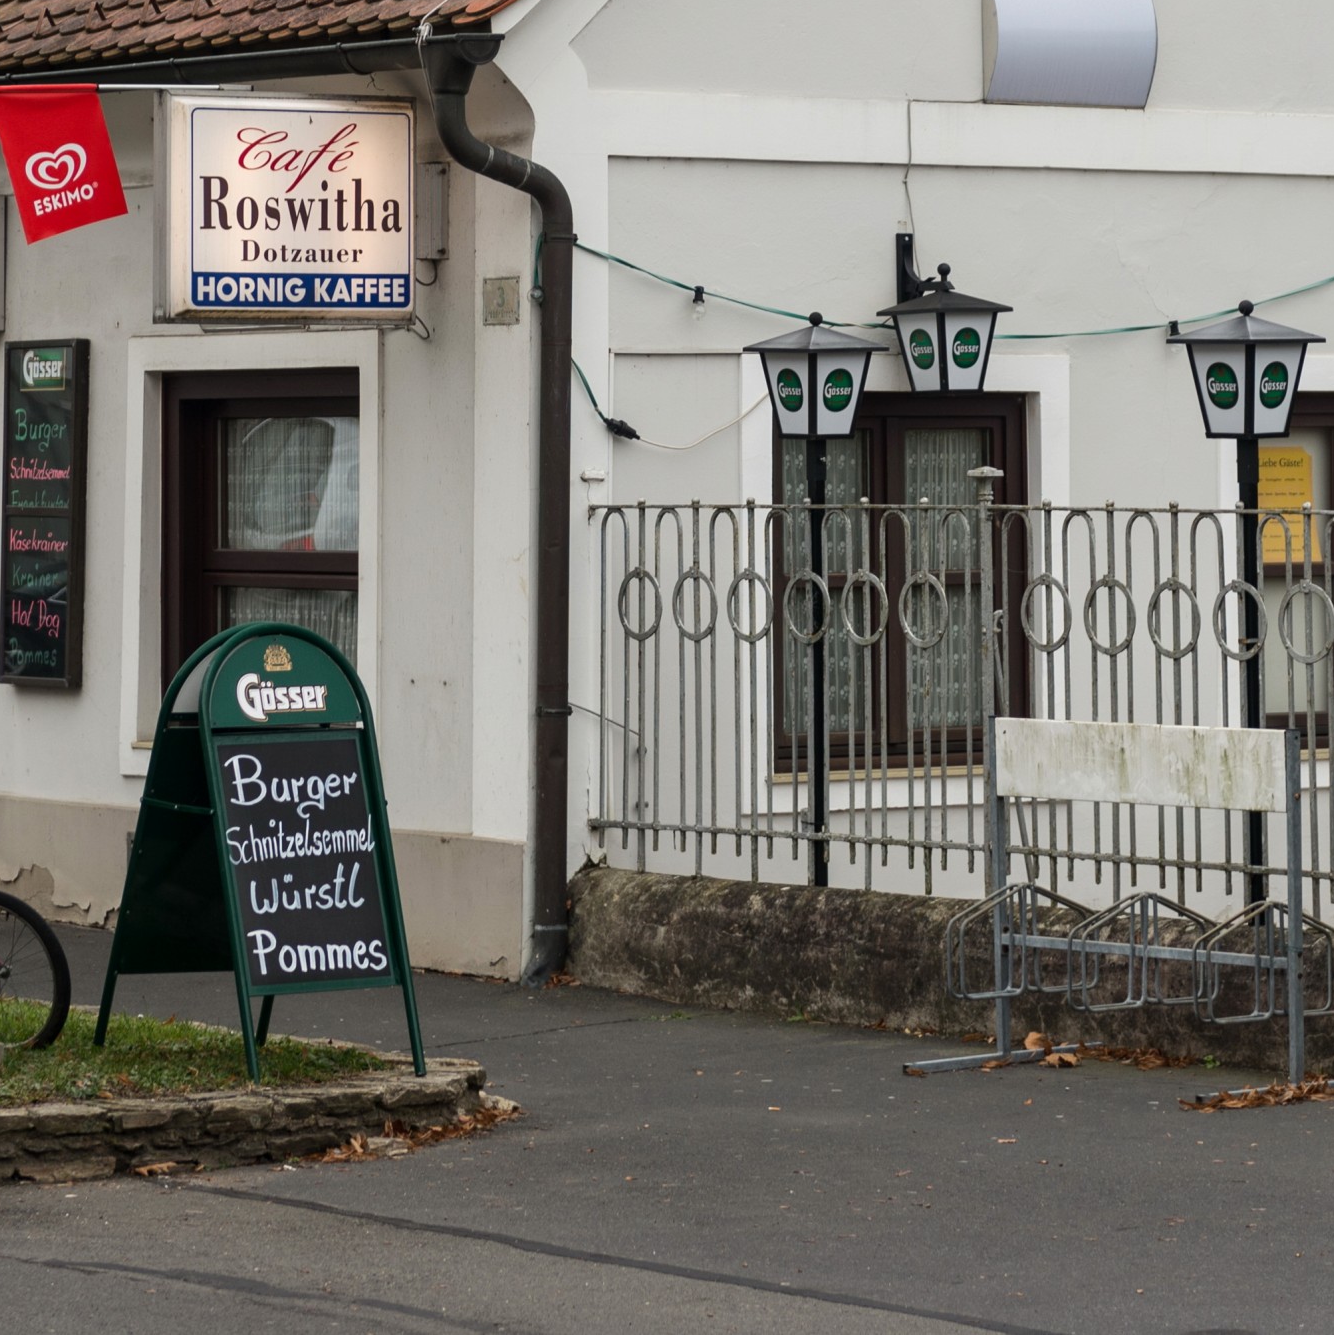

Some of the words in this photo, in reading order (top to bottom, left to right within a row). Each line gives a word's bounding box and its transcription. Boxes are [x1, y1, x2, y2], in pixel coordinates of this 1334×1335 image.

[236, 123, 360, 193] Café
[33, 184, 94, 217] ESKIMO
[199, 175, 403, 233] Roswitha
[240, 239, 363, 263] Dotzauer
[197, 276, 307, 303] HORNIG
[314, 277, 405, 304] KAFFEE
[953, 340, 980, 355] Gösser
[23, 350, 63, 386] Gösser
[1208, 377, 1237, 394] Gösser
[1261, 377, 1287, 394] Gösser
[778, 382, 803, 398] Gösser
[825, 382, 852, 398] Gösser
[15, 408, 66, 452] Burger
[13, 563, 60, 587] Krainer
[12, 599, 34, 627] Hot
[34, 599, 60, 638] Dog
[236, 672, 328, 723] Gösser
[223, 754, 358, 819] Burger
[225, 813, 376, 866] Schnitzelsemmel
[250, 861, 365, 915] Würstl
[247, 929, 388, 976] Pommes
